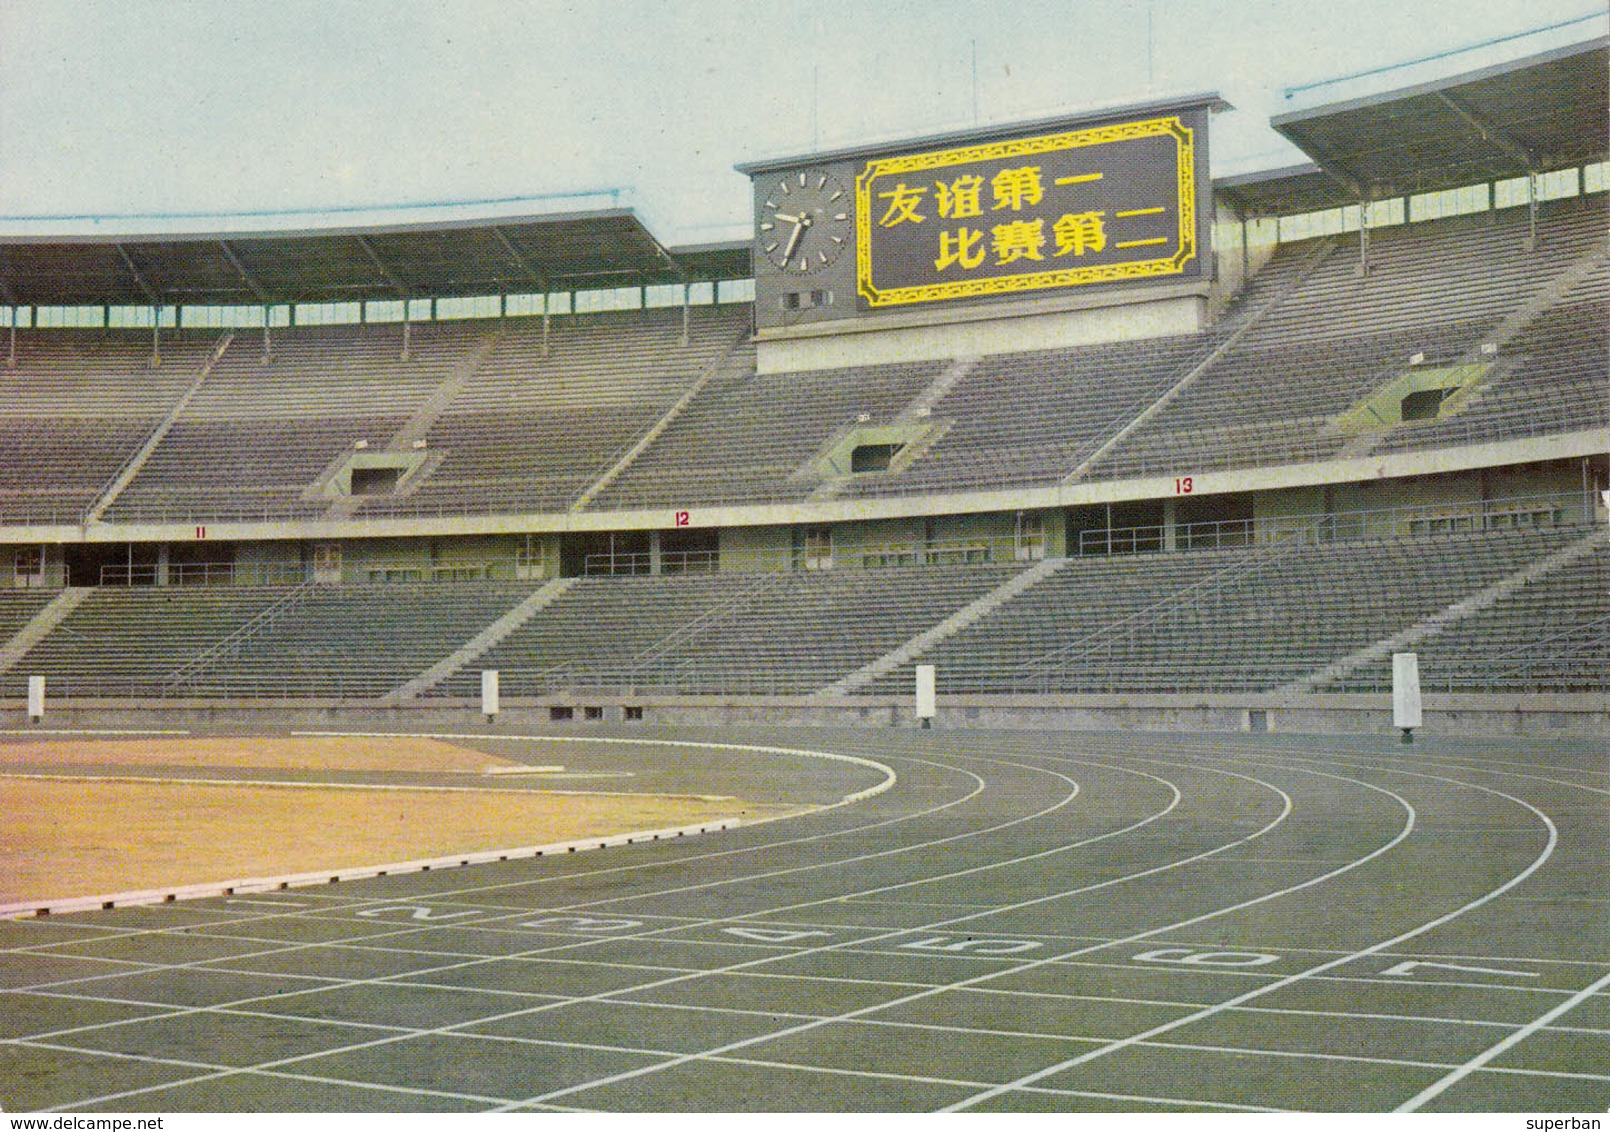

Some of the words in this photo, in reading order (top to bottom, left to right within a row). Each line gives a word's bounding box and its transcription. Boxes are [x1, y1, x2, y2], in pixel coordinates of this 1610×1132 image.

[878, 166, 1103, 228] 友谊第一
[934, 207, 1168, 271] 比赛第二
[1175, 477, 1193, 494] 13
[675, 511, 689, 526] 12
[196, 526, 206, 539] 11
[356, 906, 484, 921] 2
[519, 917, 643, 931] 3
[722, 926, 835, 942] 4
[901, 936, 1045, 953] 5
[1132, 947, 1282, 967] 6
[1380, 960, 1541, 977] 7
